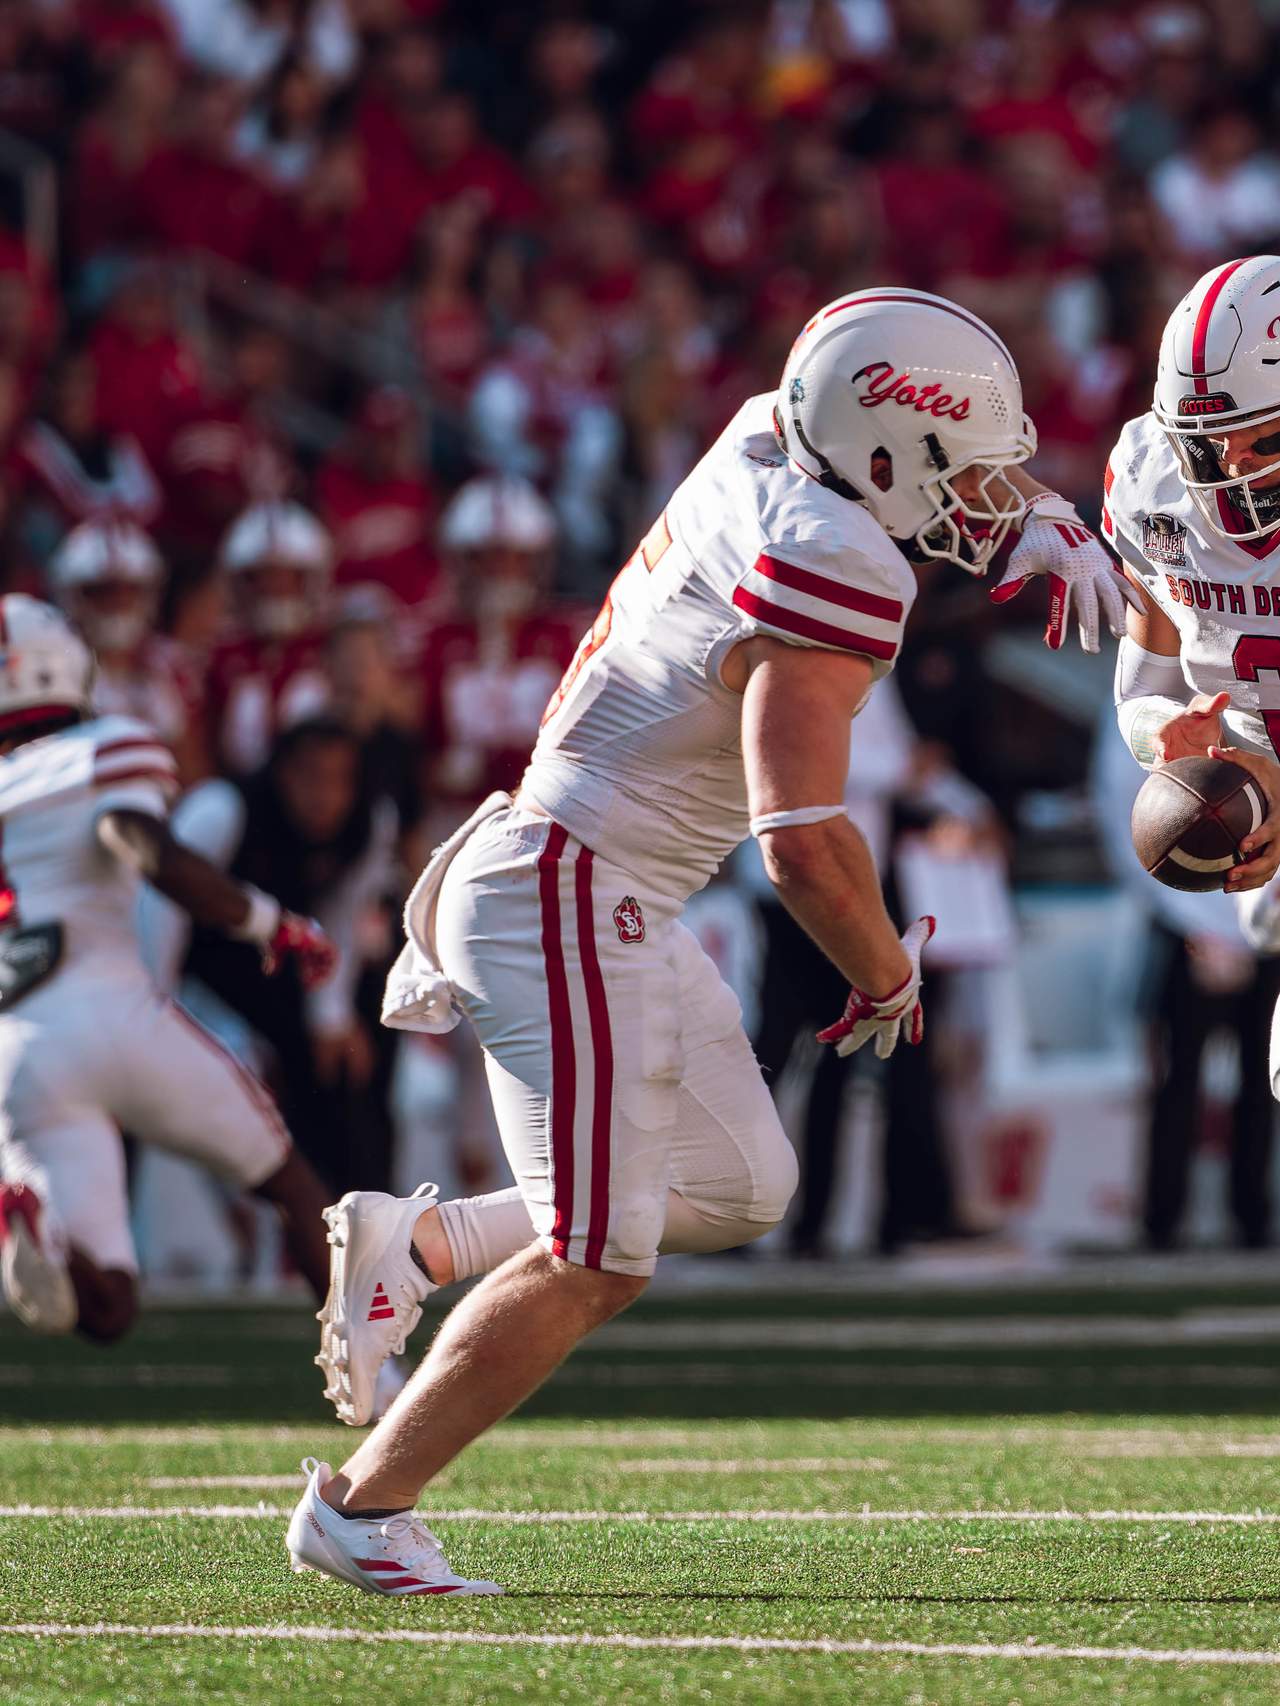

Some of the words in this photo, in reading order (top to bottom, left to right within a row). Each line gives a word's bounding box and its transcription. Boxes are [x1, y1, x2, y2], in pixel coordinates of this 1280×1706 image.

[851, 361, 970, 421] Yotes
[1180, 399, 1225, 414] YOTES
[1051, 595, 1061, 631] ADIZERO
[1165, 574, 1247, 615] SOUTH
